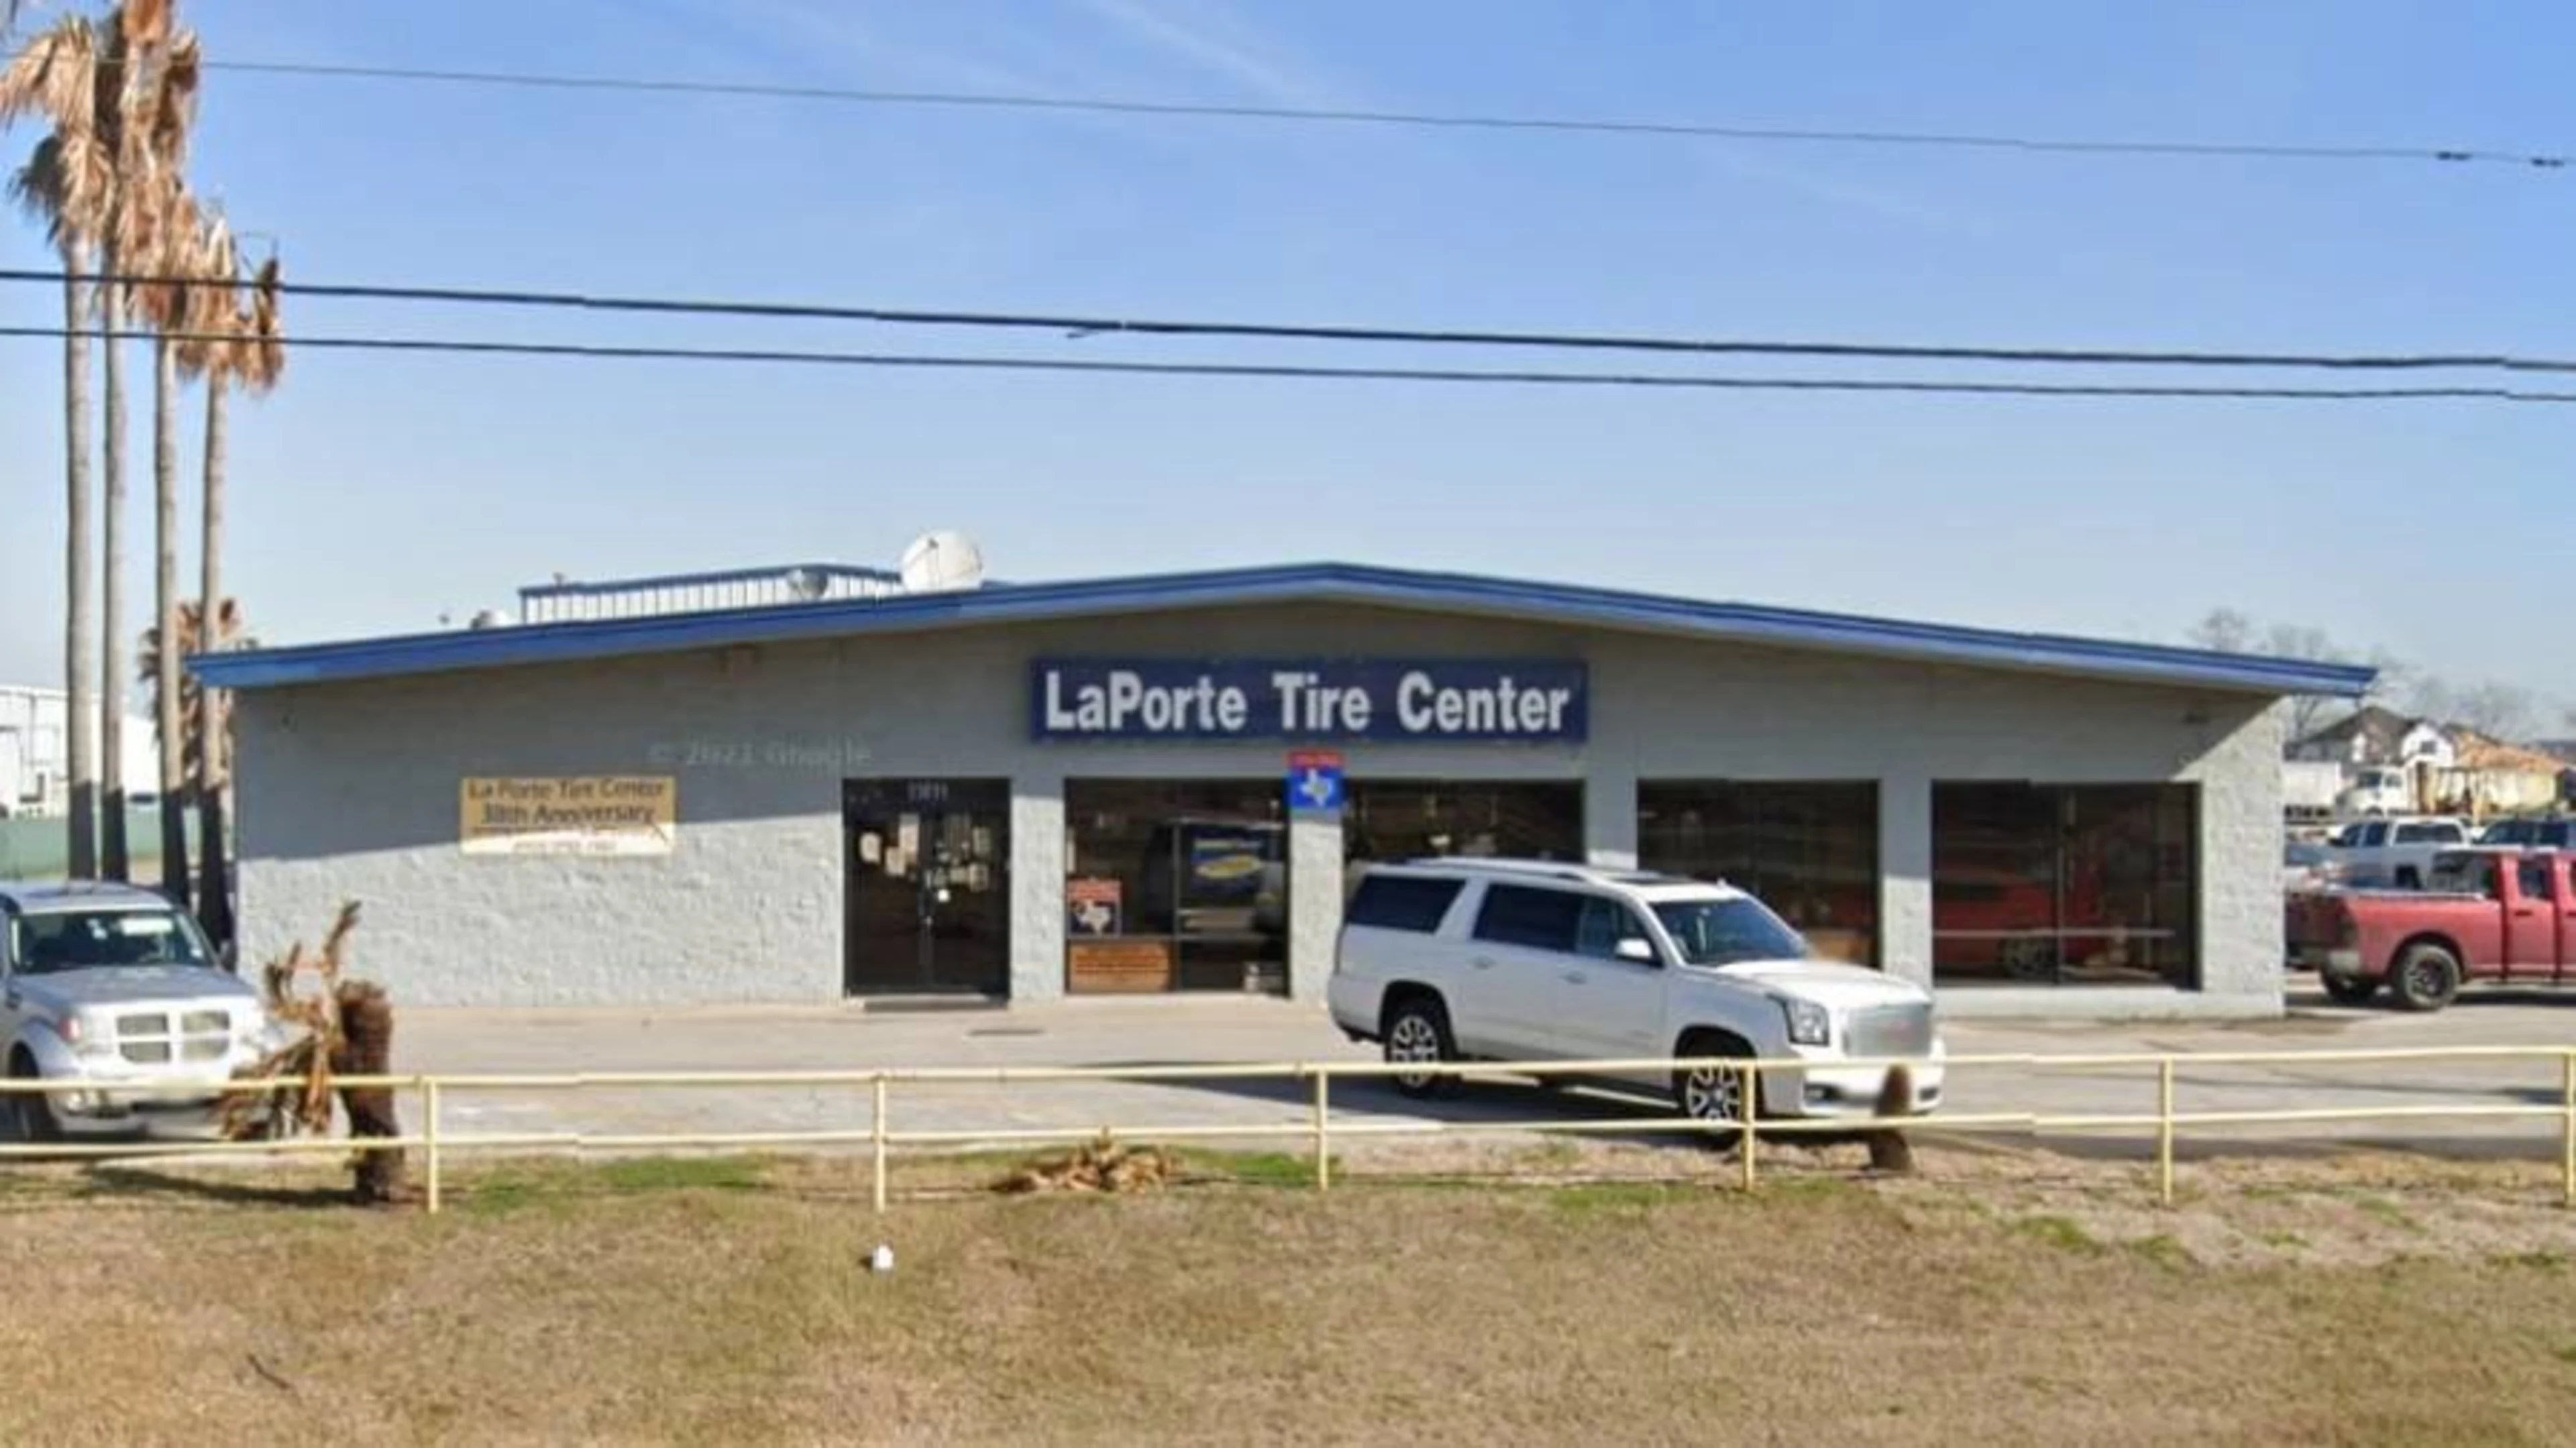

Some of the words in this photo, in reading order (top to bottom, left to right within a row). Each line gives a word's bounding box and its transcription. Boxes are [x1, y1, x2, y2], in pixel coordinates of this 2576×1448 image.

[1046, 670, 1248, 731] LaPorte
[1272, 671, 1371, 731] Tire
[1397, 671, 1570, 731] Center
[533, 803, 656, 826] Anniversary
